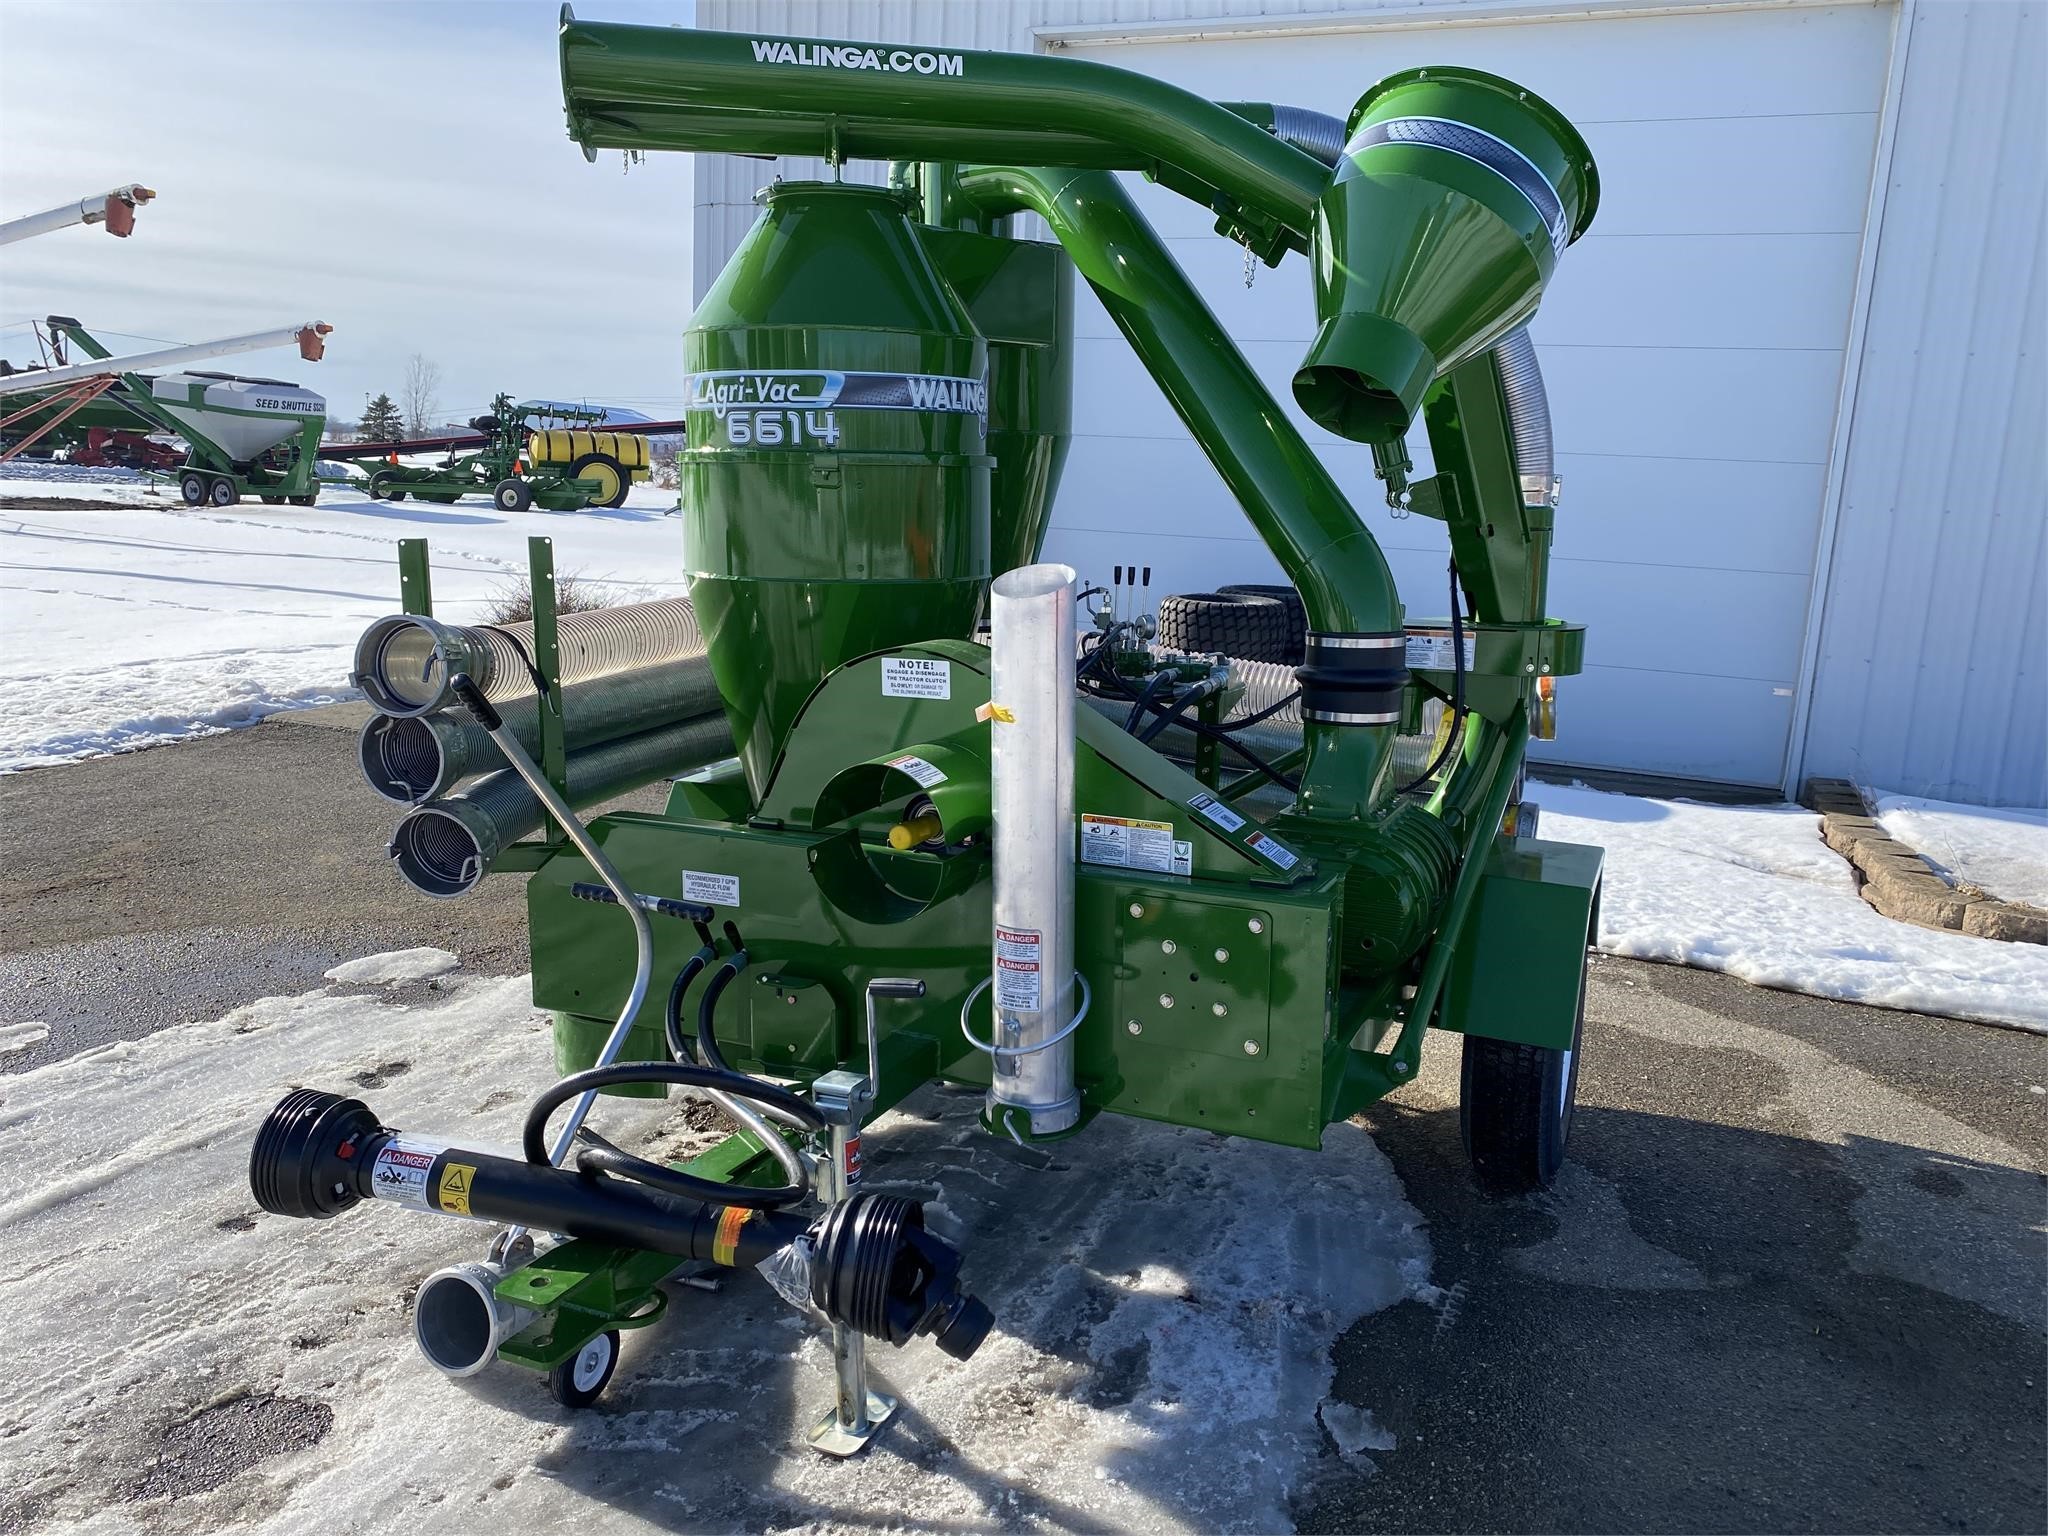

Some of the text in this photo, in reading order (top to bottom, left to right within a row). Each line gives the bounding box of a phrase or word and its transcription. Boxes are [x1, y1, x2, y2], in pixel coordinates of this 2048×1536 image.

[704, 376, 801, 419] Agri-Vac
[907, 376, 985, 411] WALING
[255, 398, 279, 409] SEED
[281, 400, 312, 412] SHUTTLE
[727, 411, 840, 445] 6614
[899, 660, 934, 670] NOTE!
[686, 874, 720, 884] RECOMMENDED
[1006, 935, 1036, 943] DANGER
[1006, 962, 1036, 971] DANGER
[393, 1154, 430, 1167] DANGER
